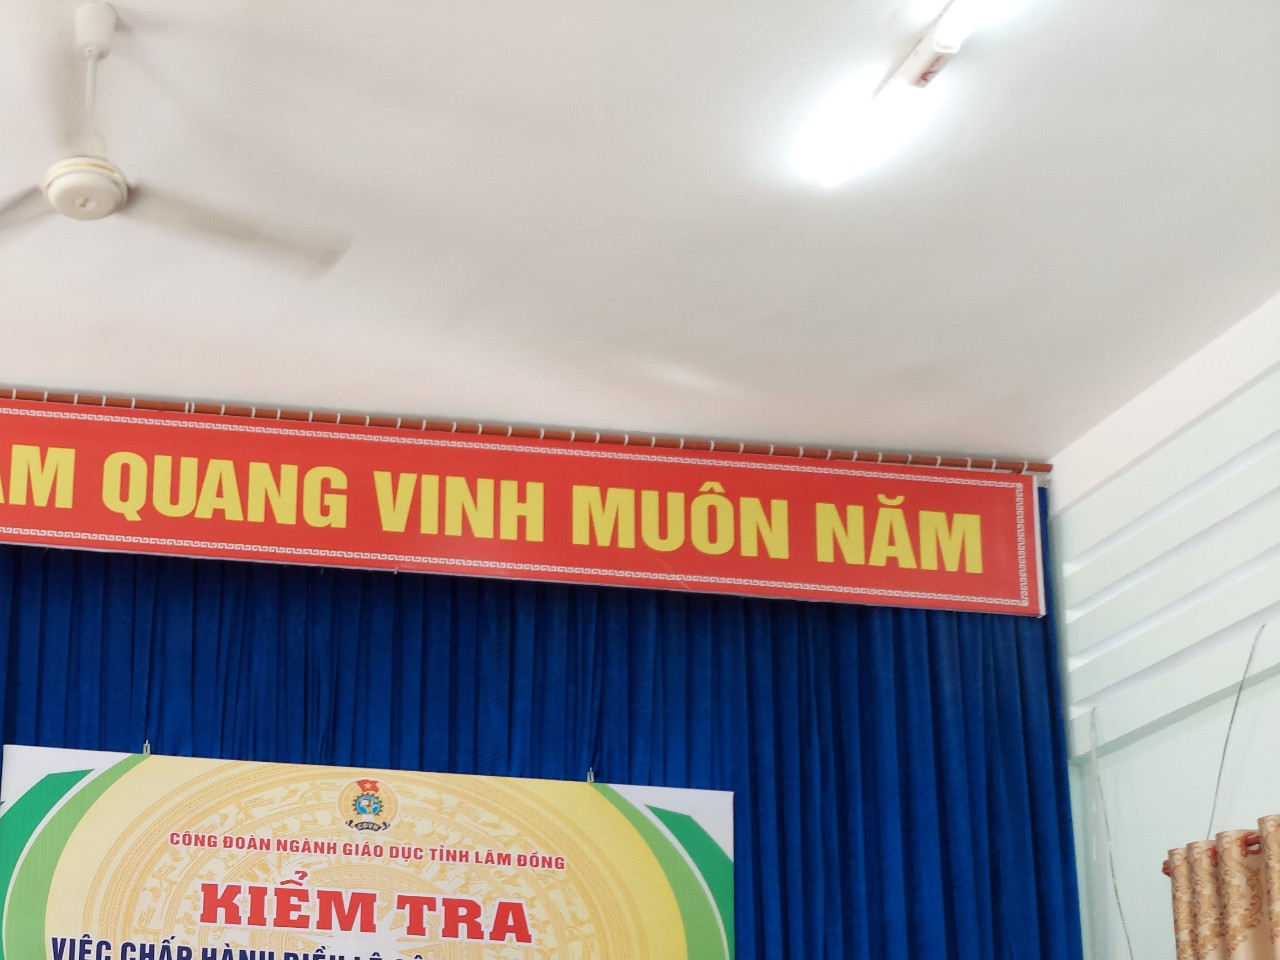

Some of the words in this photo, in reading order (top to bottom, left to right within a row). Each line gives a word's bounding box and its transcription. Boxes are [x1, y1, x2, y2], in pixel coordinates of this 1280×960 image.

[101, 451, 348, 528] QUANG
[372, 471, 545, 543] VINH
[571, 481, 789, 560] MUÔN
[815, 491, 984, 575] NĂM
[169, 831, 218, 849] CÔNG
[222, 834, 271, 851] ĐOÀN
[276, 837, 338, 856] NGÀNH
[342, 841, 383, 857] GIÁO
[389, 845, 424, 862] DỤC
[430, 844, 469, 864] TỈNH
[474, 846, 513, 866] LÂM
[199, 870, 378, 934] KIỂM
[396, 894, 533, 944] TRA
